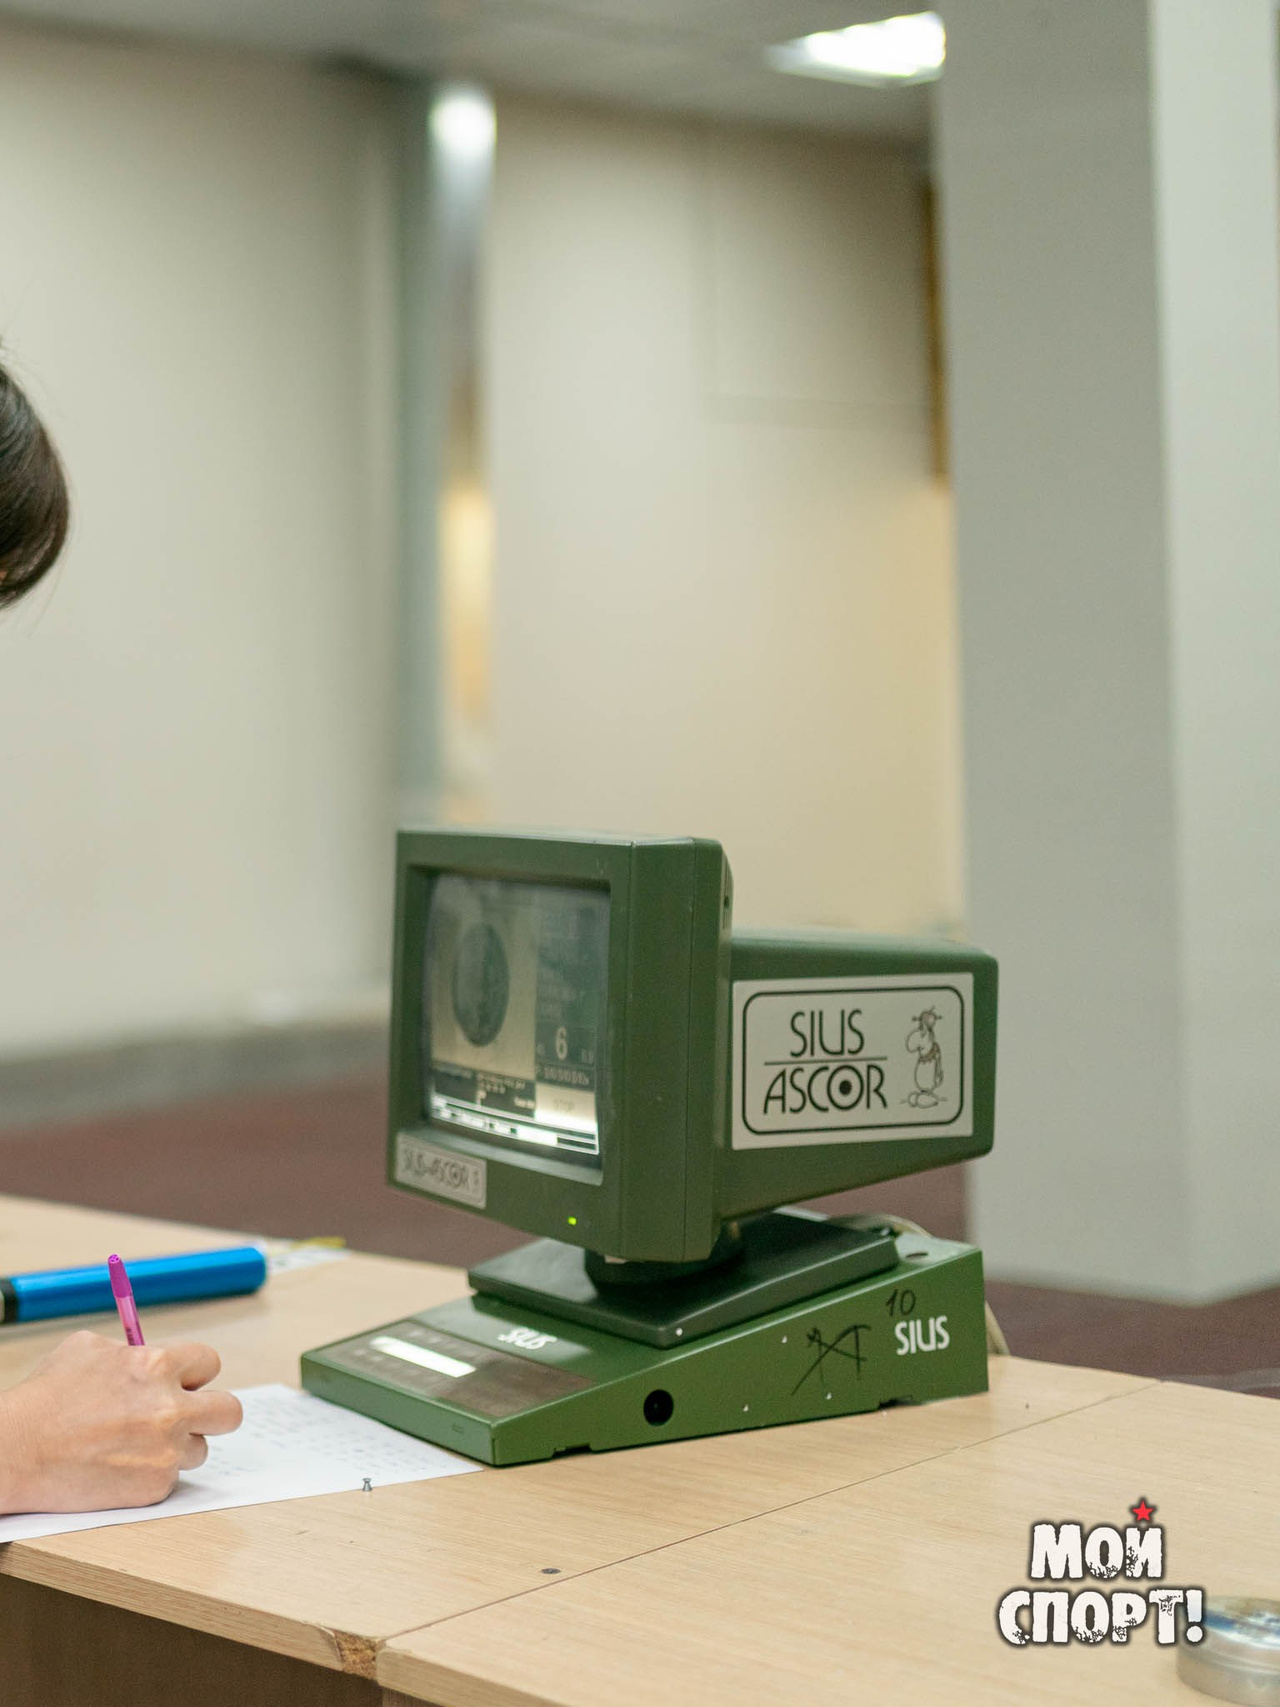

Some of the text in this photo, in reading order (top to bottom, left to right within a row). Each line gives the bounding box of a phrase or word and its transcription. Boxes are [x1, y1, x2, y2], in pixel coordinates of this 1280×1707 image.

[555, 1026, 568, 1061] 6
[790, 1008, 865, 1057] SIUS
[763, 1064, 888, 1115] ASCOR
[885, 1288, 917, 1317] 10
[895, 1315, 950, 1356] SIUS
